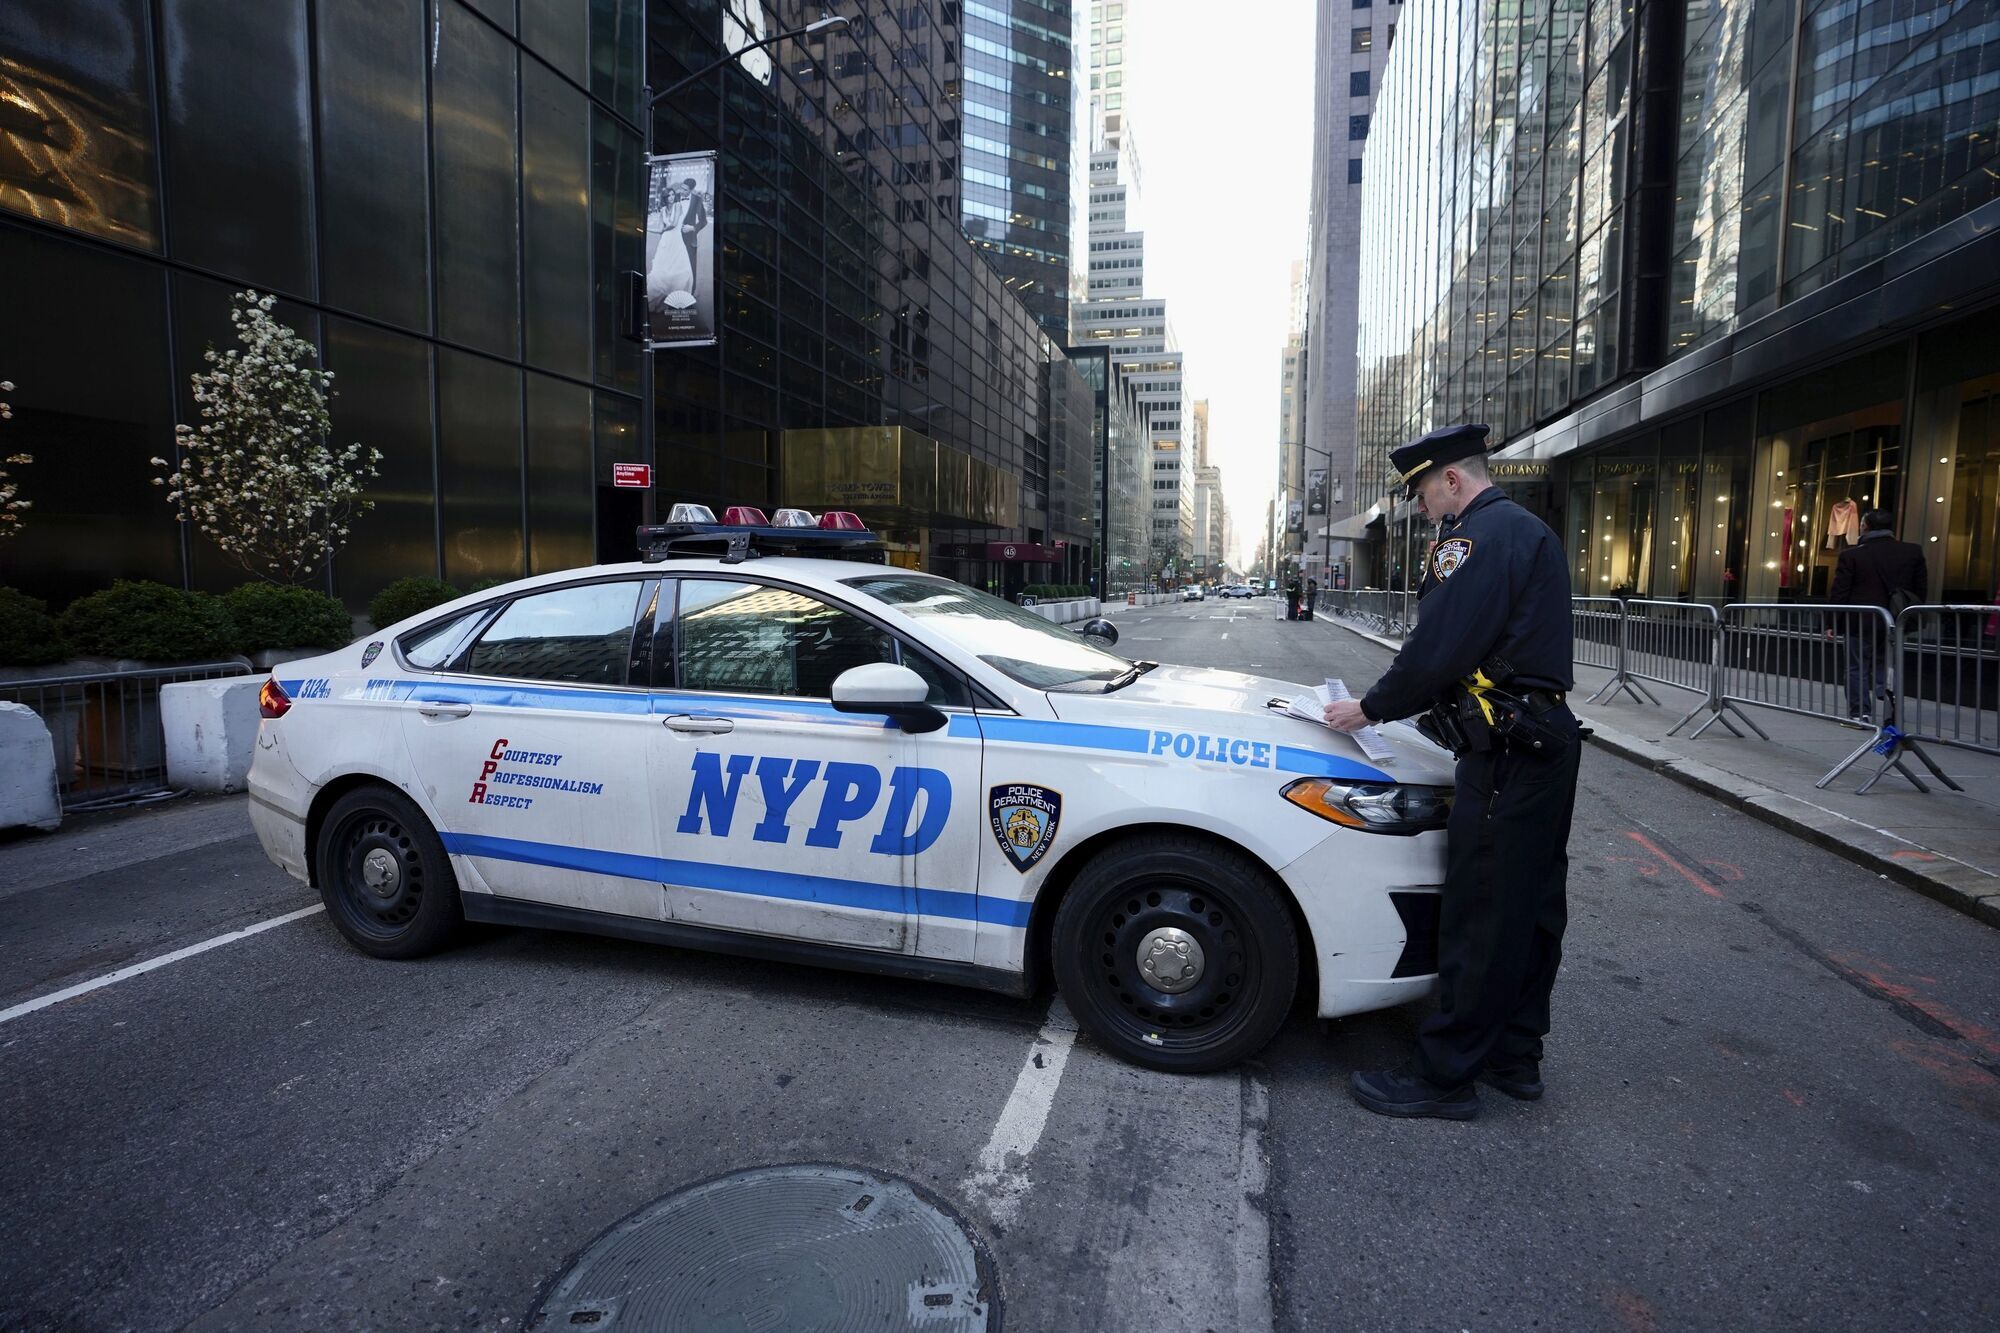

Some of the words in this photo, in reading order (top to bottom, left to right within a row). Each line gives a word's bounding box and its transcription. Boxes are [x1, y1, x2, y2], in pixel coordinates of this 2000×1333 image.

[1488, 464, 1550, 475] STORANTE
[1005, 547, 1015, 556] 45
[301, 679, 329, 699] 3124
[490, 738, 563, 767] COURTESY
[1151, 730, 1271, 769] POLICE
[479, 760, 604, 795] PROFESSIONALISM
[468, 782, 533, 810] RESPECT
[676, 751, 953, 856] NYPD
[993, 795, 1056, 814] DEPARTMENT
[1008, 786, 1043, 799] POLICE
[992, 817, 1005, 839] CITY
[1001, 841, 1013, 854] OF
[1031, 843, 1047, 861] NEW
[1044, 820, 1056, 842] YORK
